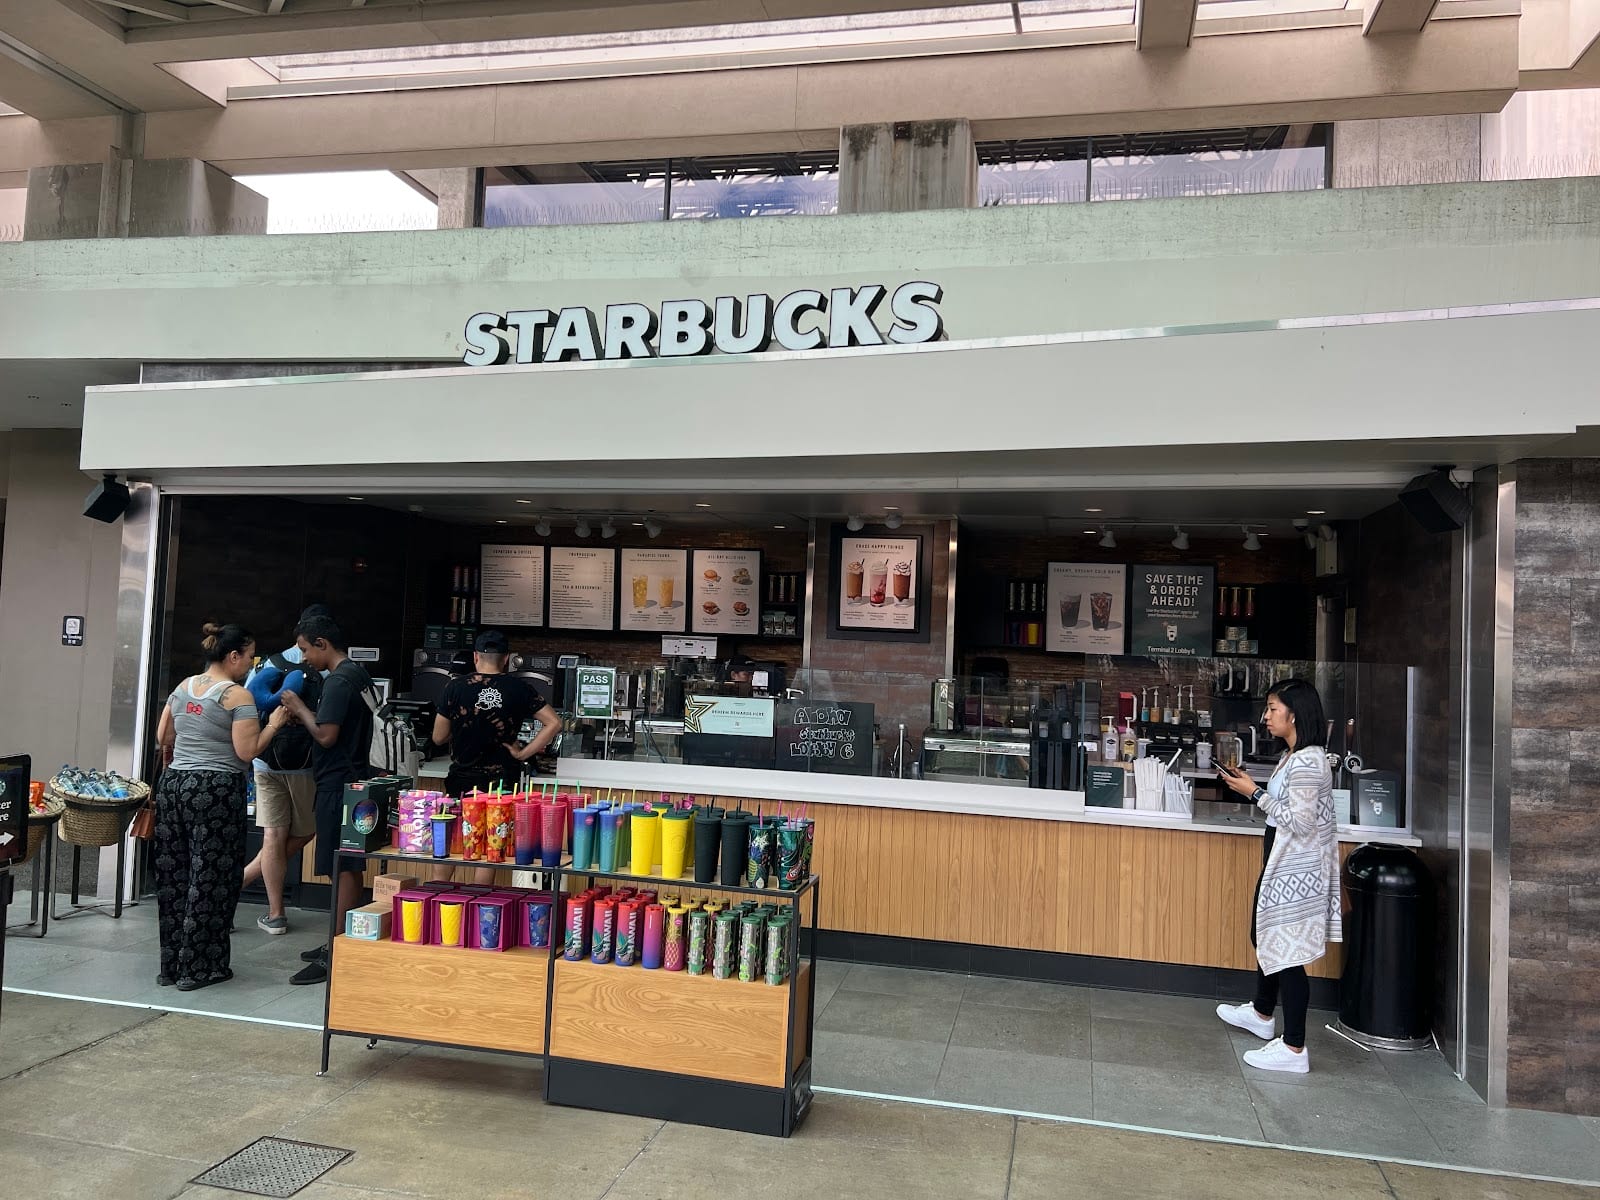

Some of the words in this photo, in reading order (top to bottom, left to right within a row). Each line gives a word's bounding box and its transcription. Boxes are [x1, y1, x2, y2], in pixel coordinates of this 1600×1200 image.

[463, 281, 944, 367] STARBUCKS
[1145, 573, 1174, 584] SAVE
[1176, 574, 1204, 585] TIME
[1149, 584, 1157, 594] &
[1160, 585, 1199, 596] ORDER
[1151, 596, 1195, 607] AHEAD!
[1174, 647, 1191, 655] Lobby
[583, 675, 609, 684] PASS
[840, 743, 855, 759] 6
[410, 799, 426, 847] ALOHA
[572, 907, 583, 949] HAWAII
[602, 909, 613, 952] HAWAII
[627, 912, 637, 954] HAWAII
